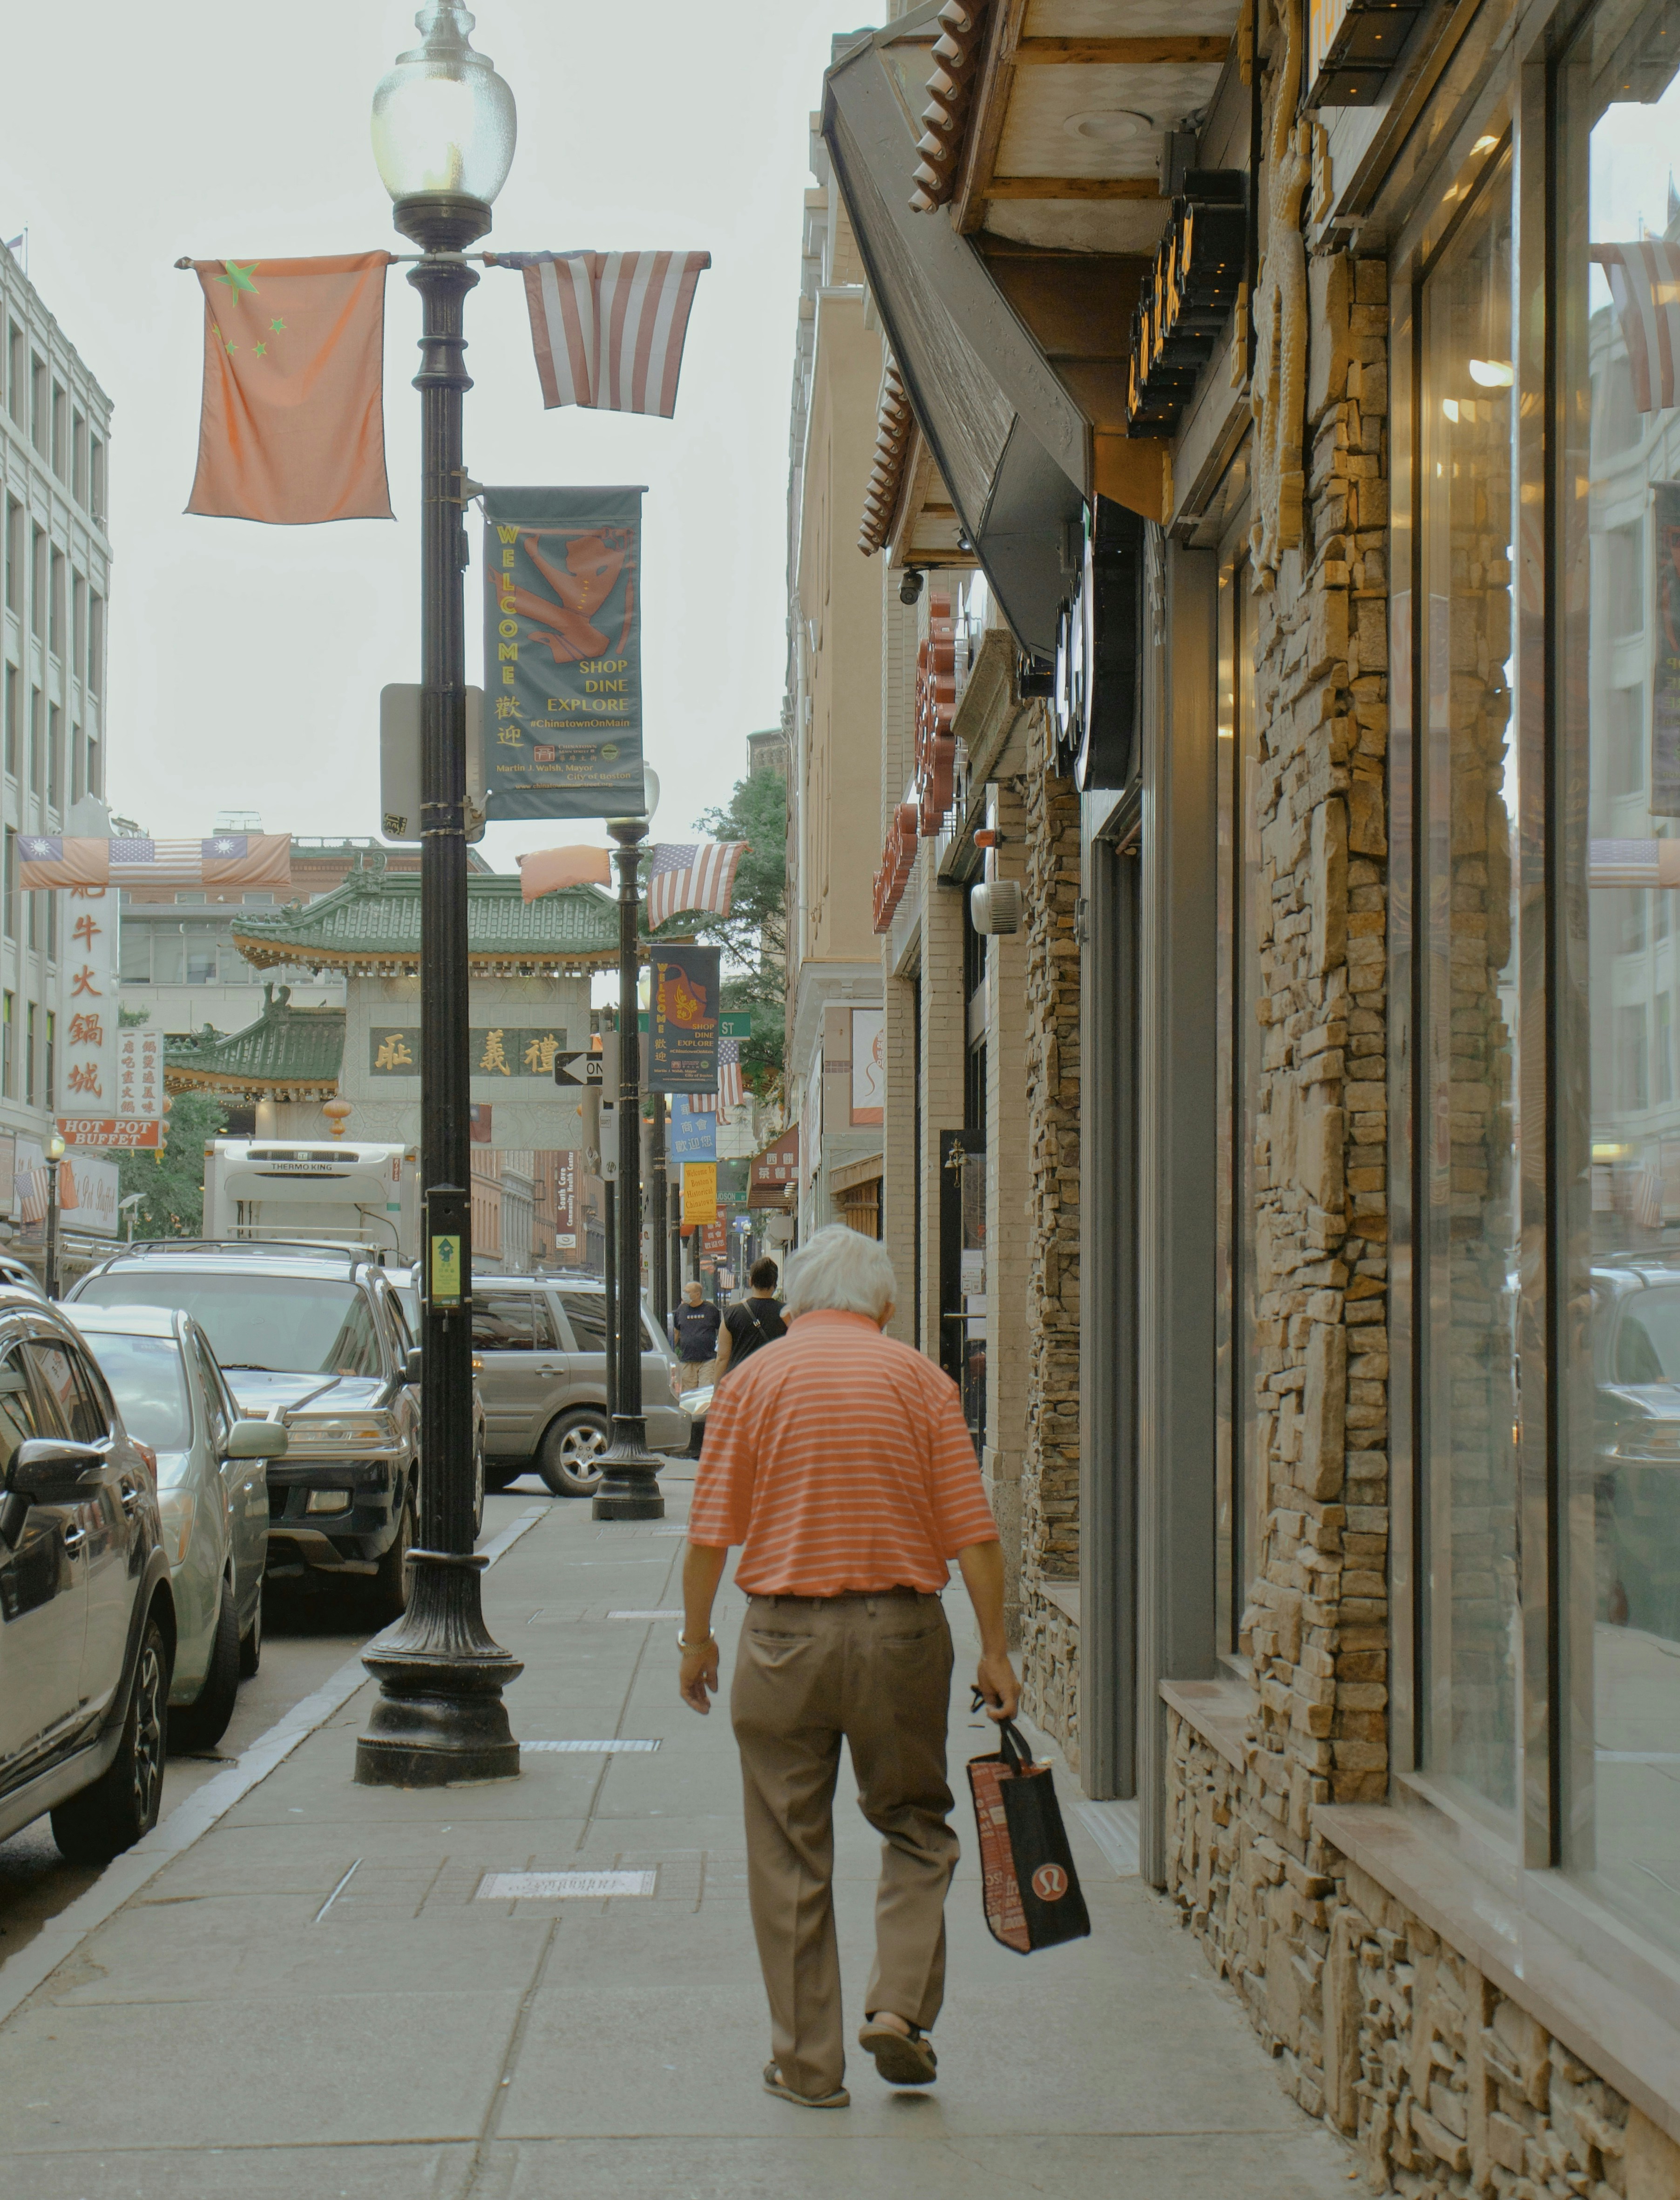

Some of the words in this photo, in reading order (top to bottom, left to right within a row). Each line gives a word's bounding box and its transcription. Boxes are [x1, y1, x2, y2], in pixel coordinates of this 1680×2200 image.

[496, 526, 520, 684] WELCOME
[579, 660, 628, 673] SHOP
[585, 679, 629, 692] DINE
[548, 698, 629, 711] EXPLORE
[494, 696, 524, 747] 歡迎
[530, 719, 630, 727] #ChinatownOnMain
[536, 764, 564, 773] Walsh,
[657, 963, 668, 1033] WELCOME
[722, 1022, 734, 1034] ST
[587, 1062, 603, 1074] ON
[64, 1120, 105, 1133] HOT
[114, 1120, 151, 1134] POT
[681, 1118, 707, 1134] 商會
[75, 1133, 141, 1146] BUFFET
[686, 1168, 707, 1177] Welcome
[691, 1177, 713, 1187] Boston's
[687, 1187, 713, 1198] Historical
[717, 1192, 736, 1201] UDSON
[686, 1198, 713, 1209] Chinatown
